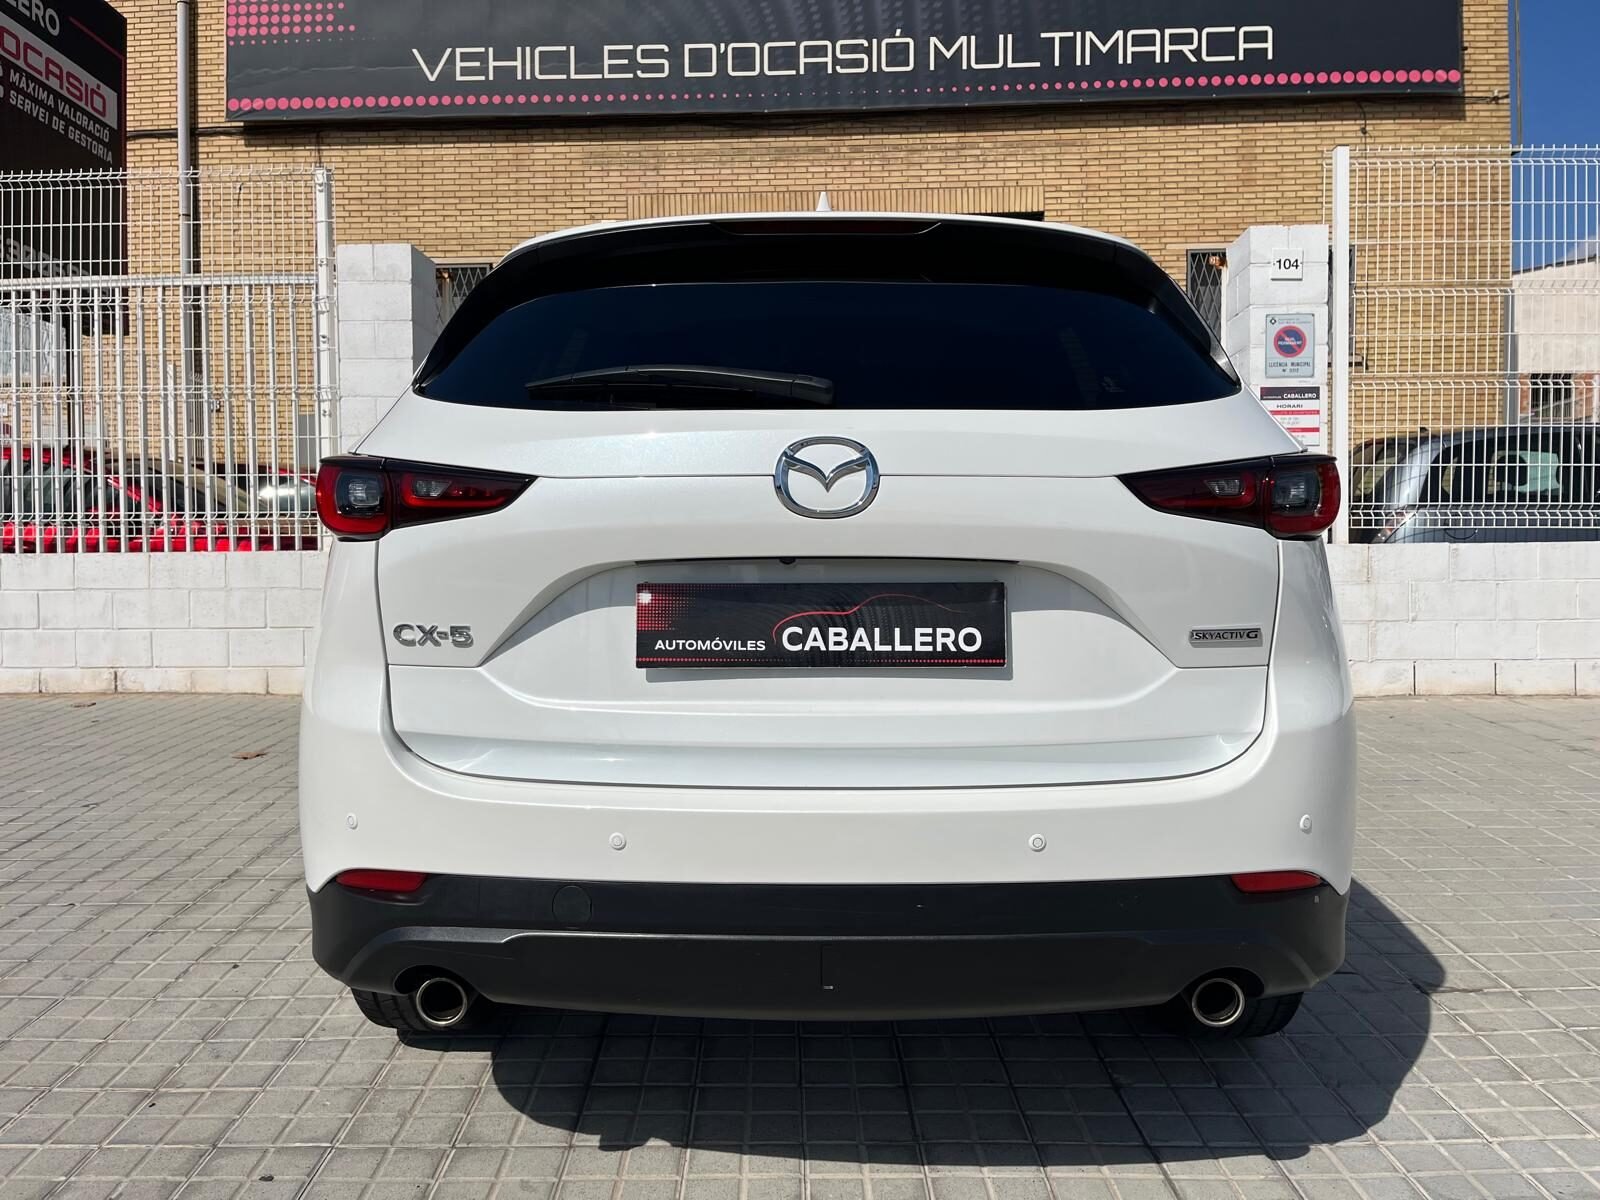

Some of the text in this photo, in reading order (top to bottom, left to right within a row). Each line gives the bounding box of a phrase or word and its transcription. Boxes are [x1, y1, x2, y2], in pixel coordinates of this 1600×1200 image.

[411, 25, 1273, 82] VEHICLES D'OCASIÓ MULTIMARCA
[9, 69, 110, 143] MÀXIMA VALORACIÓ
[9, 90, 113, 165] SERVEI DE GESTORIA
[1276, 258, 1300, 270] 104
[392, 623, 474, 649] CX-5
[654, 626, 982, 653] AUTOMÓVILES CABALLERO
